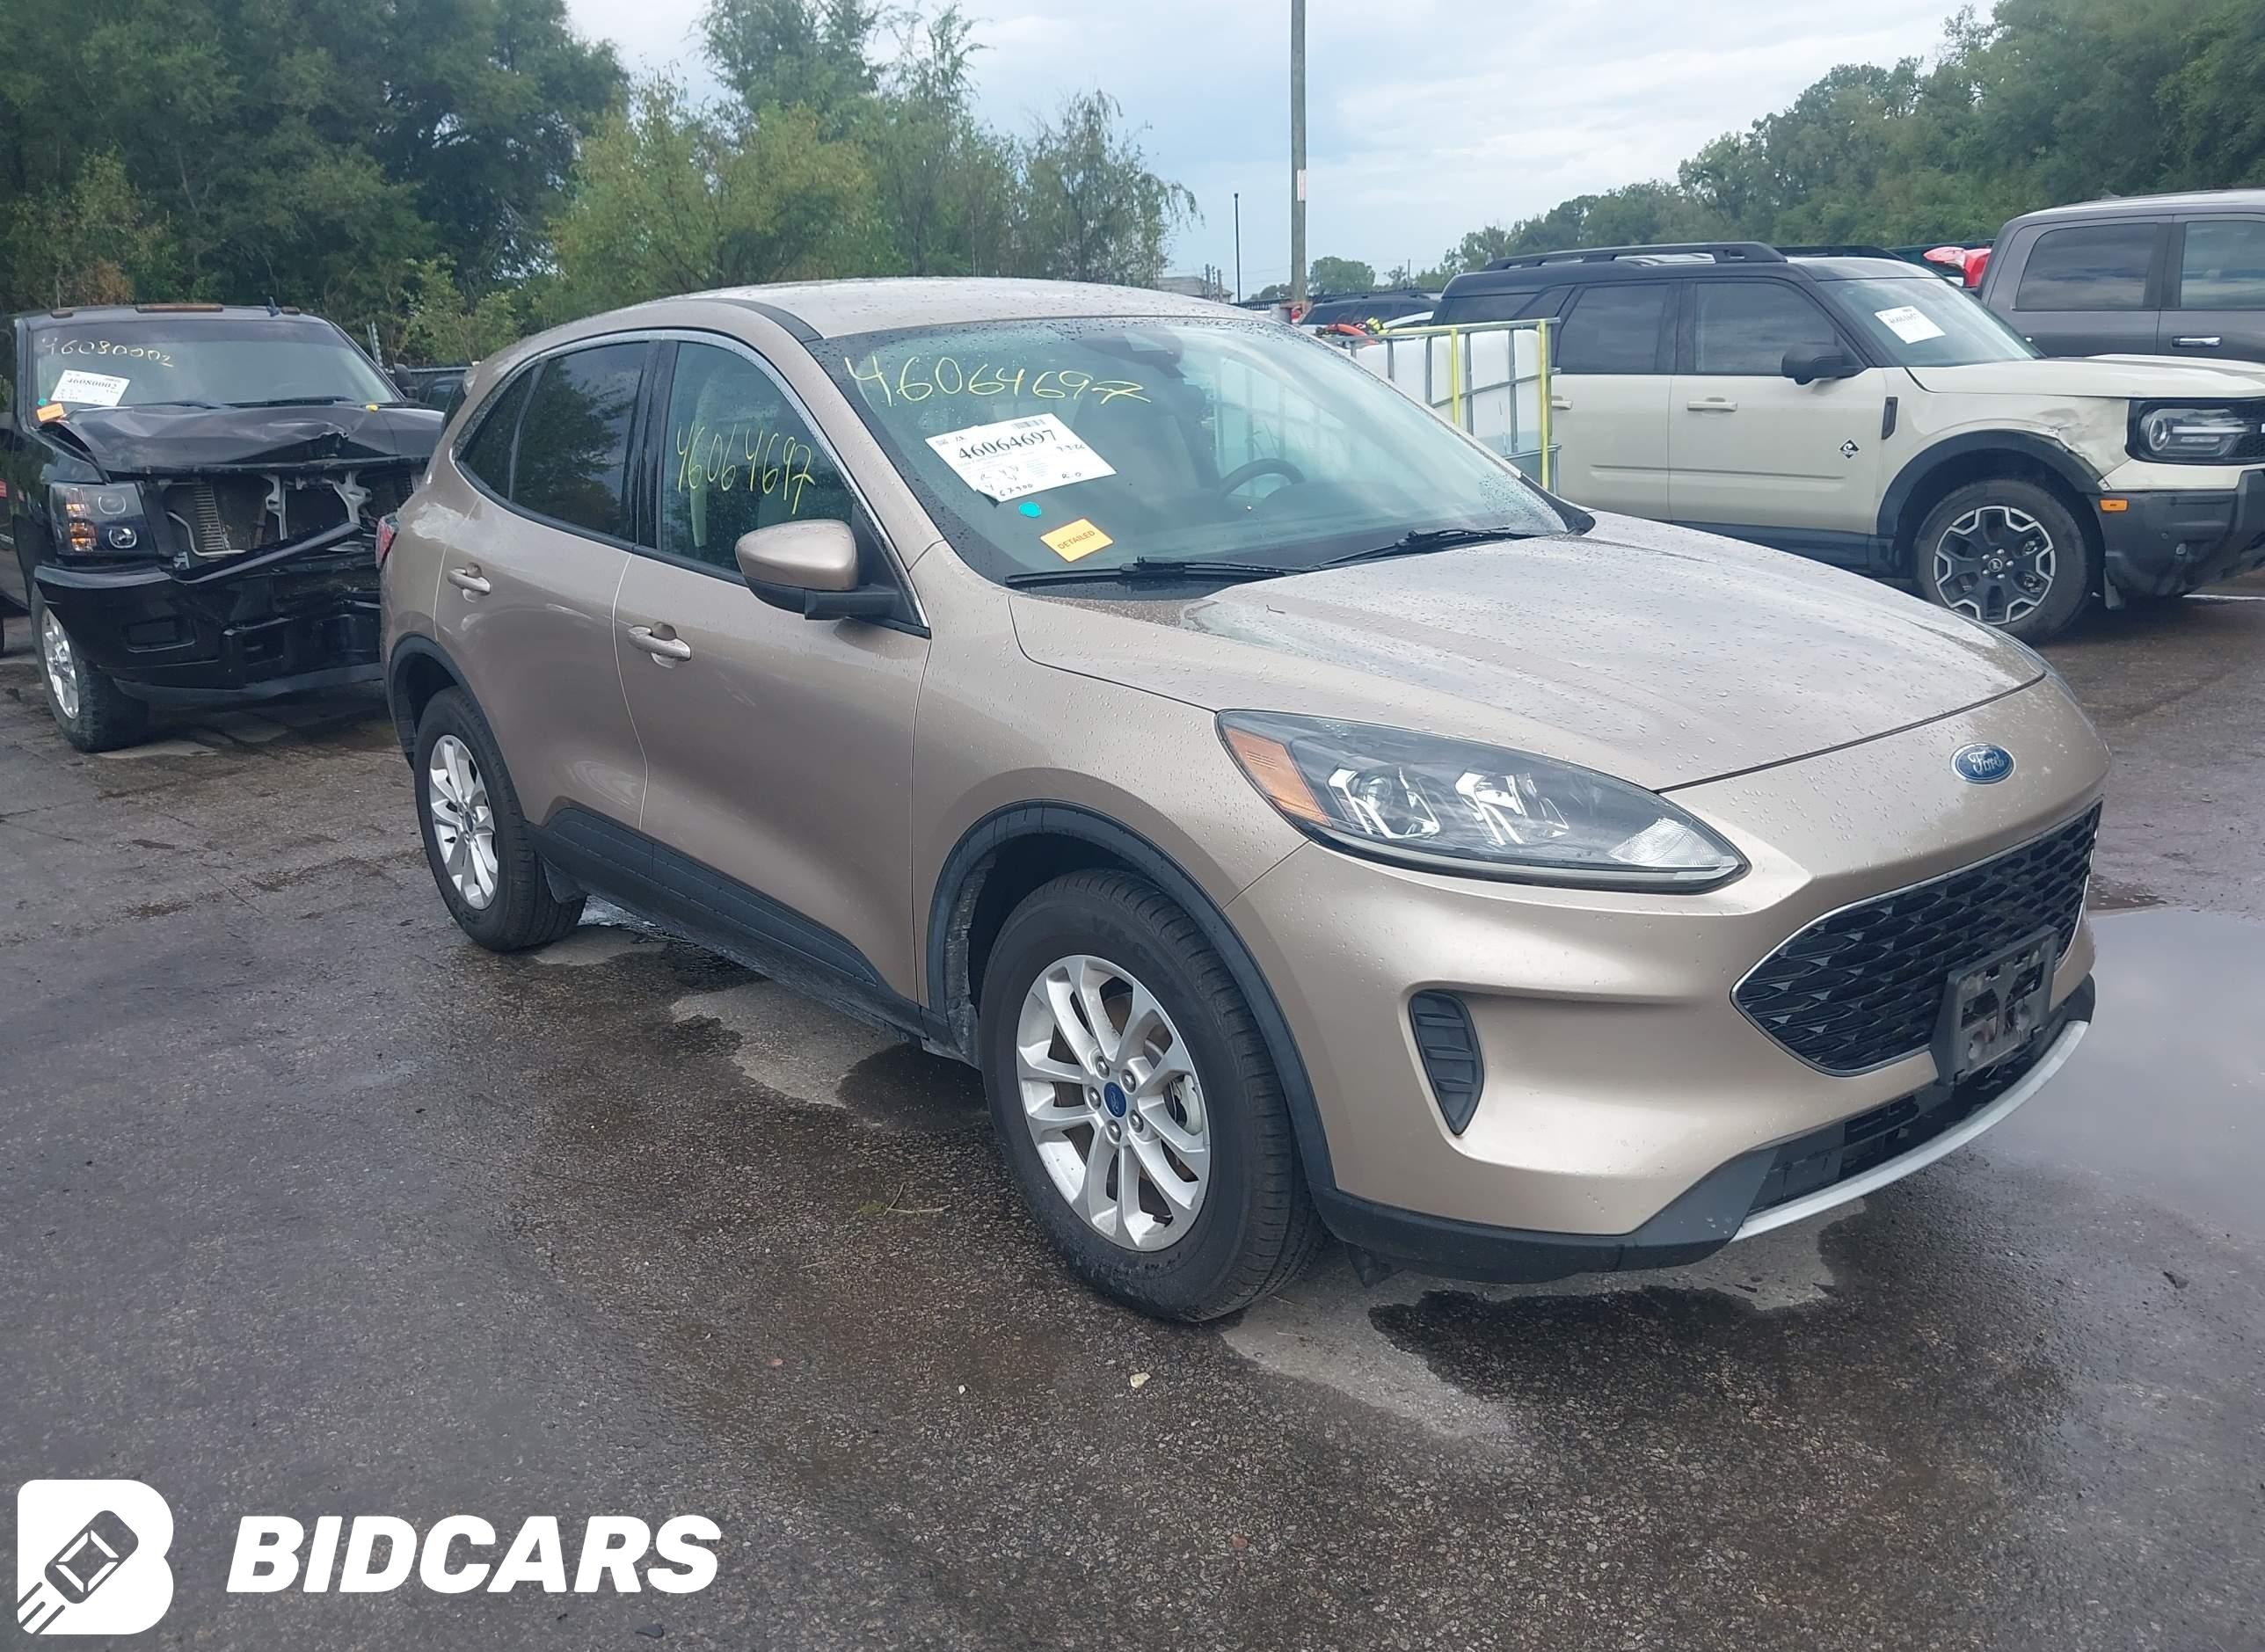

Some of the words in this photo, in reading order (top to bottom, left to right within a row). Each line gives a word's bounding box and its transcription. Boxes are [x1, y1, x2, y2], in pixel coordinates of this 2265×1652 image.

[42, 337, 174, 368] 46080002
[844, 354, 1152, 408] 46064697
[958, 428, 1057, 461] 46064697
[676, 421, 816, 515] 46064697
[1057, 530, 1096, 549] DETAILED
[1967, 750, 2005, 775] Ford
